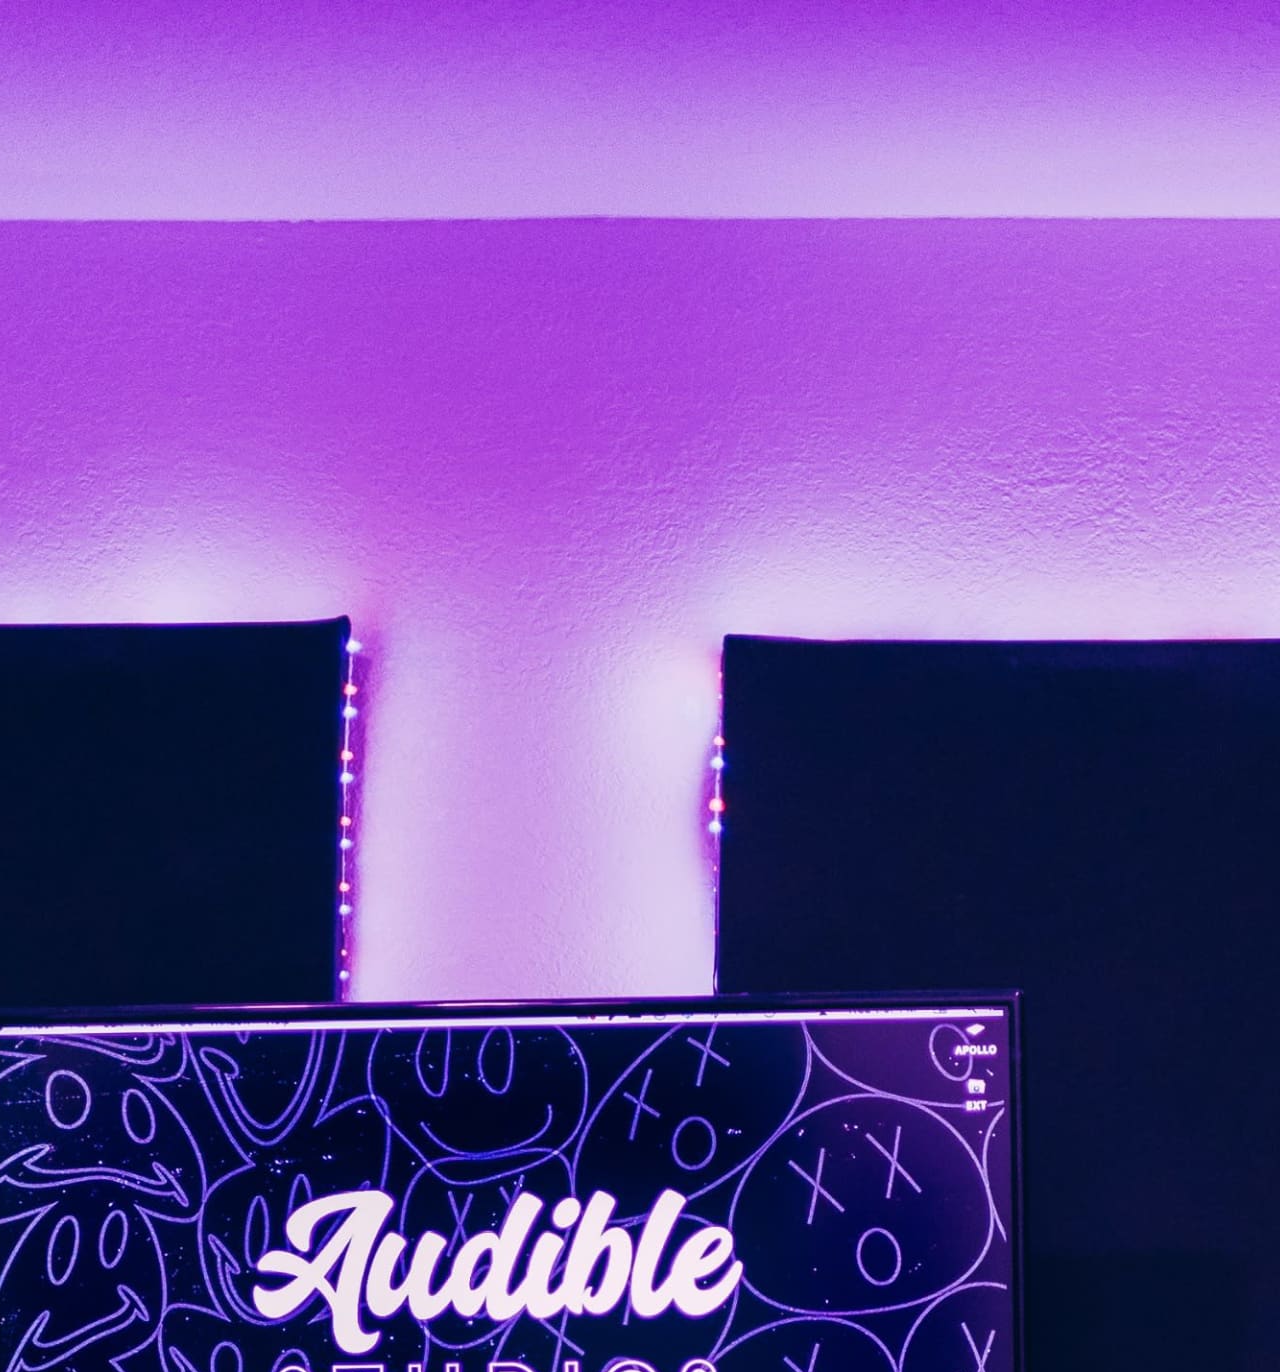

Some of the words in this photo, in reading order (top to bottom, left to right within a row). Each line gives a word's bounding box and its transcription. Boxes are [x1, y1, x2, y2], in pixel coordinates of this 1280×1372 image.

[954, 1044, 997, 1056] APOLLO
[965, 1100, 987, 1111] EXT
[254, 1189, 742, 1353] Audible
